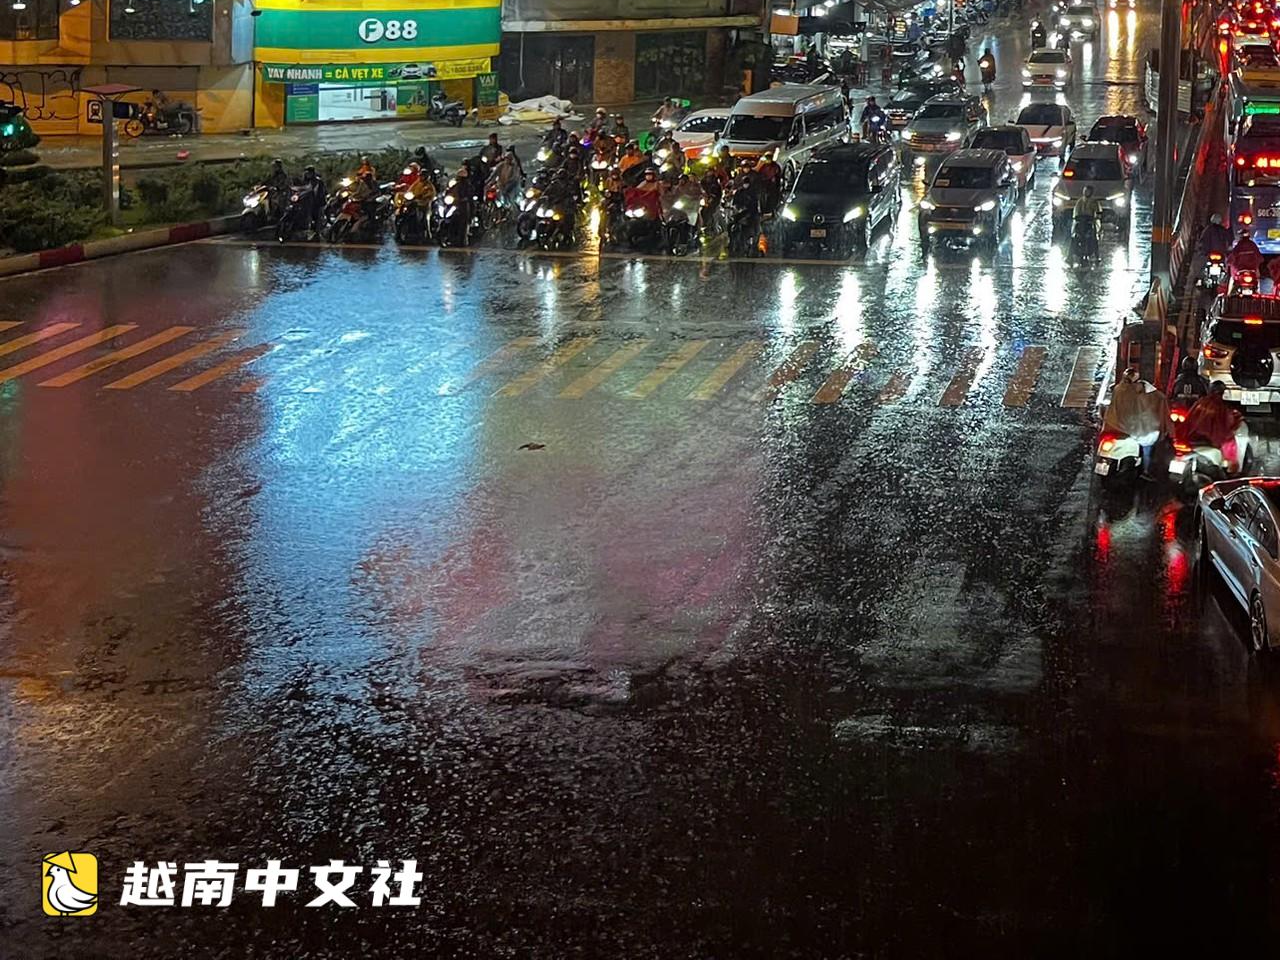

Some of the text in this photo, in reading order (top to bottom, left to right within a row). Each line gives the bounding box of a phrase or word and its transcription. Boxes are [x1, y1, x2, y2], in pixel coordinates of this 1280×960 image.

[358, 17, 418, 42] F88
[267, 67, 285, 79] VAY
[287, 68, 323, 79] NHANH
[371, 68, 384, 78] XE
